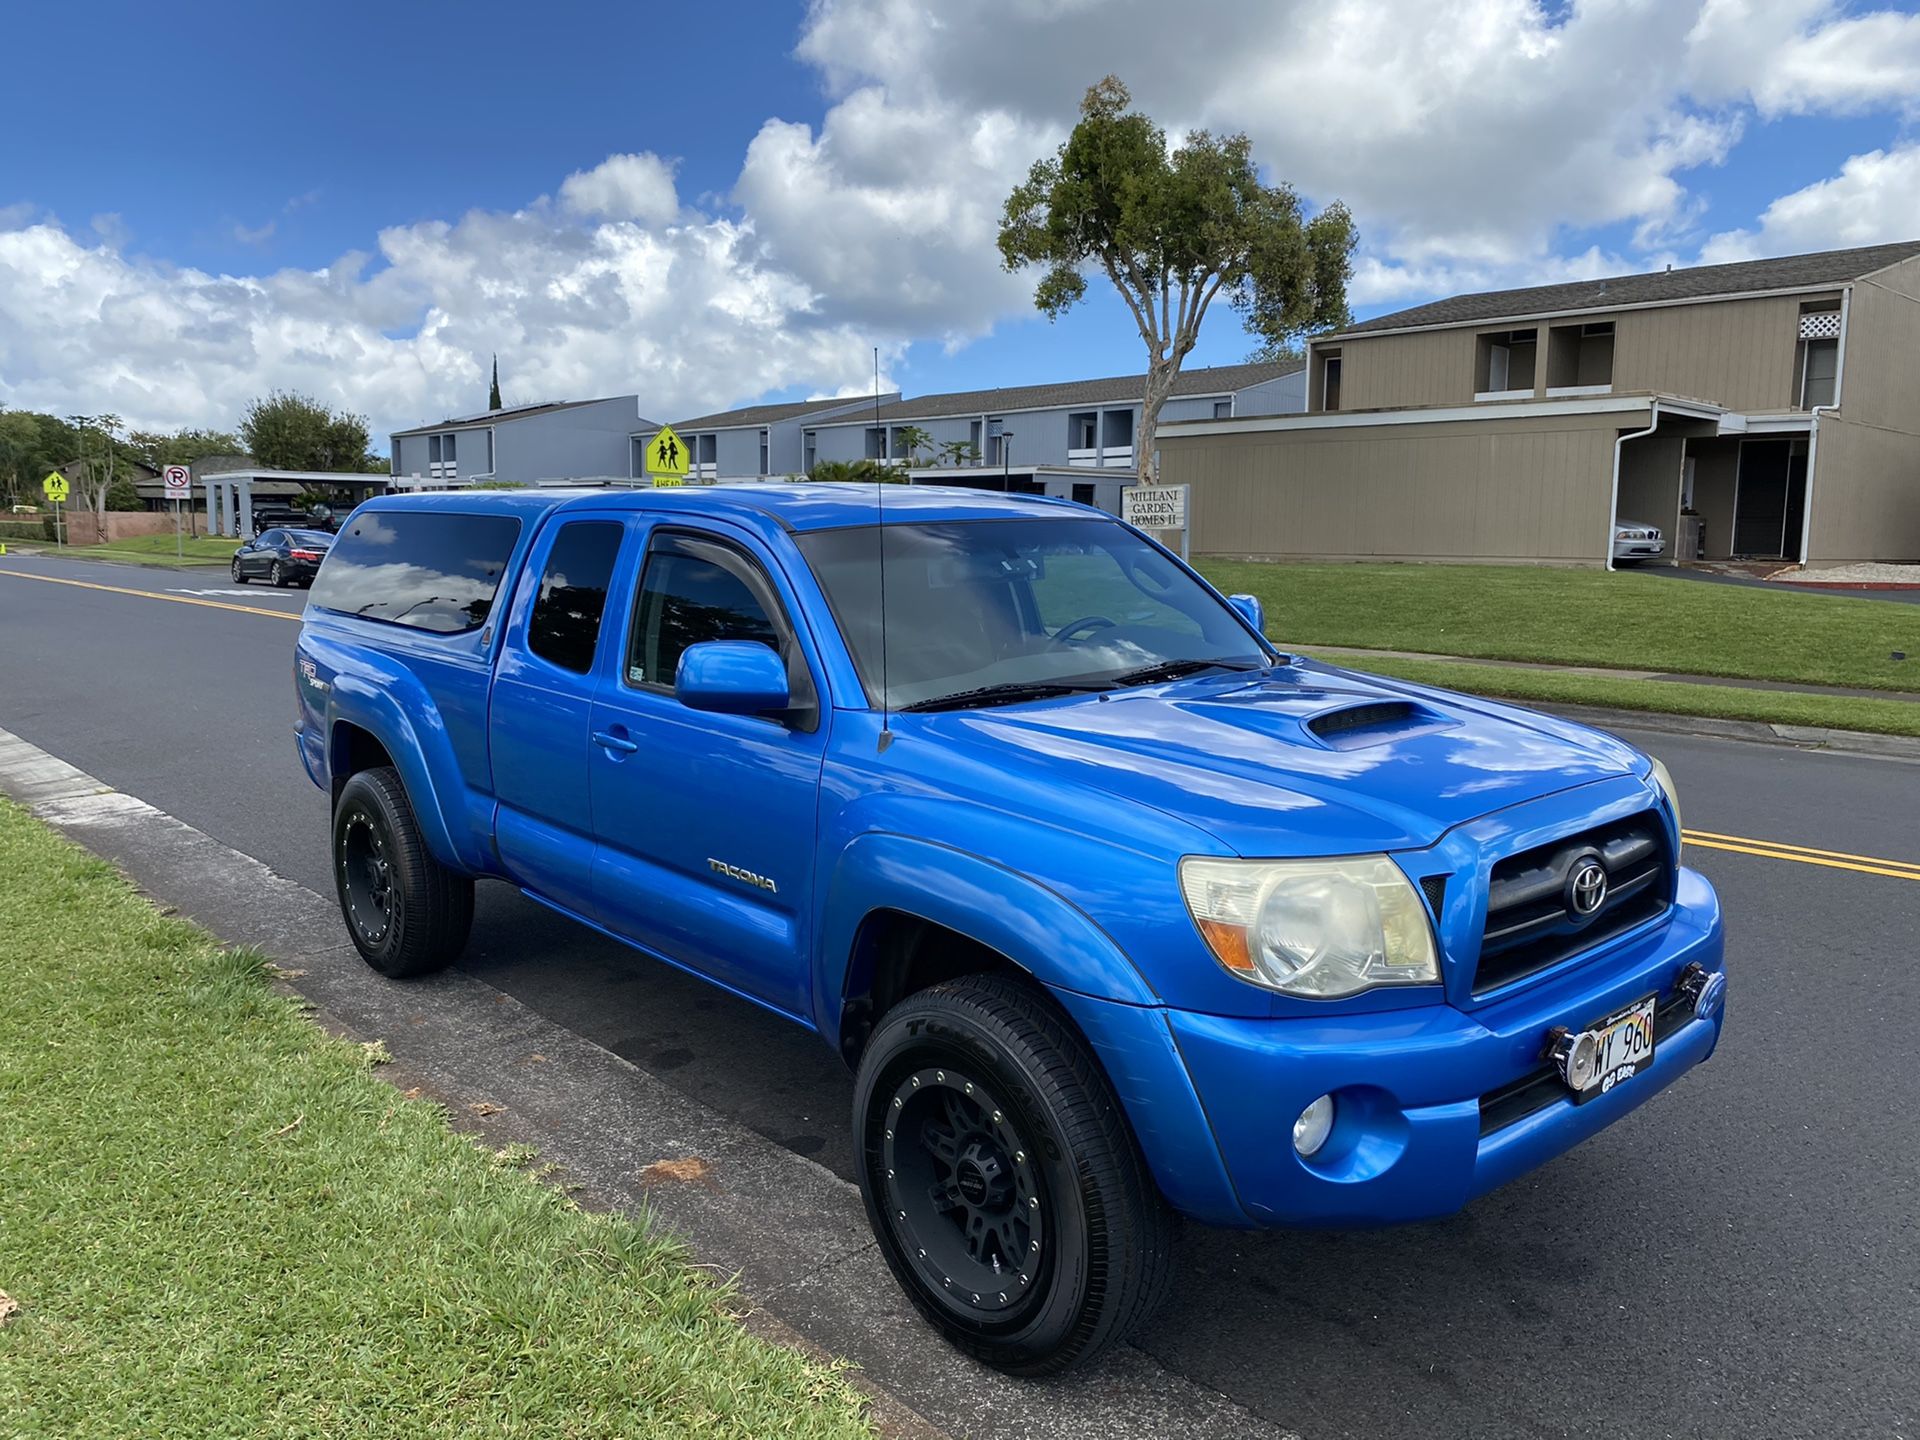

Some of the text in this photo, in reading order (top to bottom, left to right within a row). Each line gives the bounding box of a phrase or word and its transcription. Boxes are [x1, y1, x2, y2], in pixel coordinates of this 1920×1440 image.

[656, 479, 680, 488] AHEAD
[1130, 490, 1177, 502] MILILANI
[1132, 503, 1175, 514] GARDEN
[1130, 515, 1176, 525] HOMES II
[707, 857, 777, 893] TACOMA
[1624, 1012, 1653, 1060] 960
